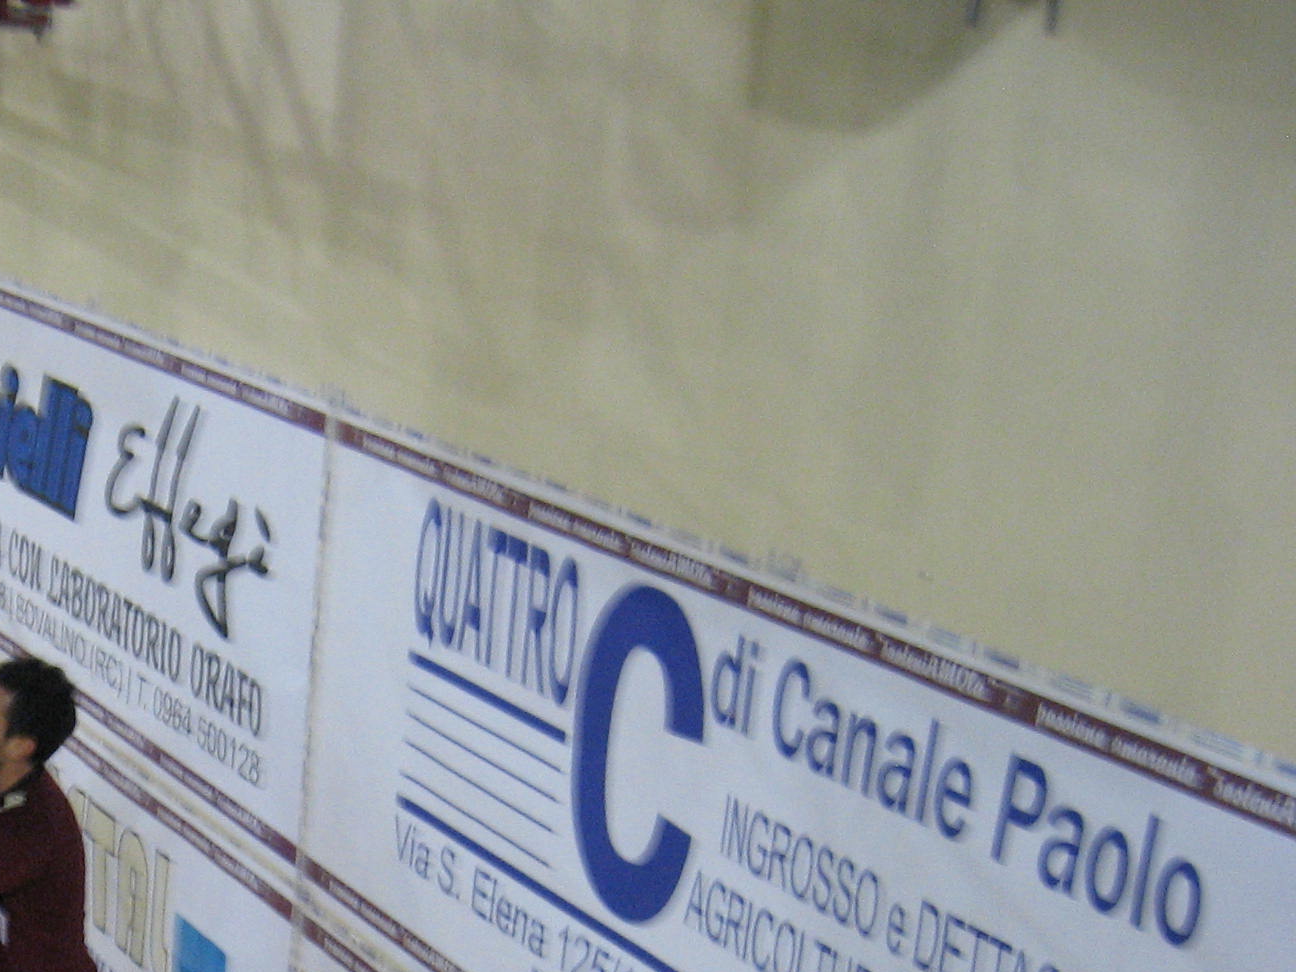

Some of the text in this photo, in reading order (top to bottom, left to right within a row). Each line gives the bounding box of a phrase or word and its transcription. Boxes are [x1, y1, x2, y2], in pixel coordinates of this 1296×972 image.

[8, 527, 43, 592] CON
[46, 553, 182, 684] LABORATORIO
[189, 643, 262, 738] ORAFO
[415, 497, 579, 708] QUATTRO
[571, 581, 704, 926] C
[710, 632, 1203, 947] di Canale Paolo
[394, 813, 432, 882] Via
[436, 843, 462, 901] S.
[470, 865, 548, 961] Elena
[720, 793, 880, 939] INGROSSO
[886, 901, 908, 956] e
